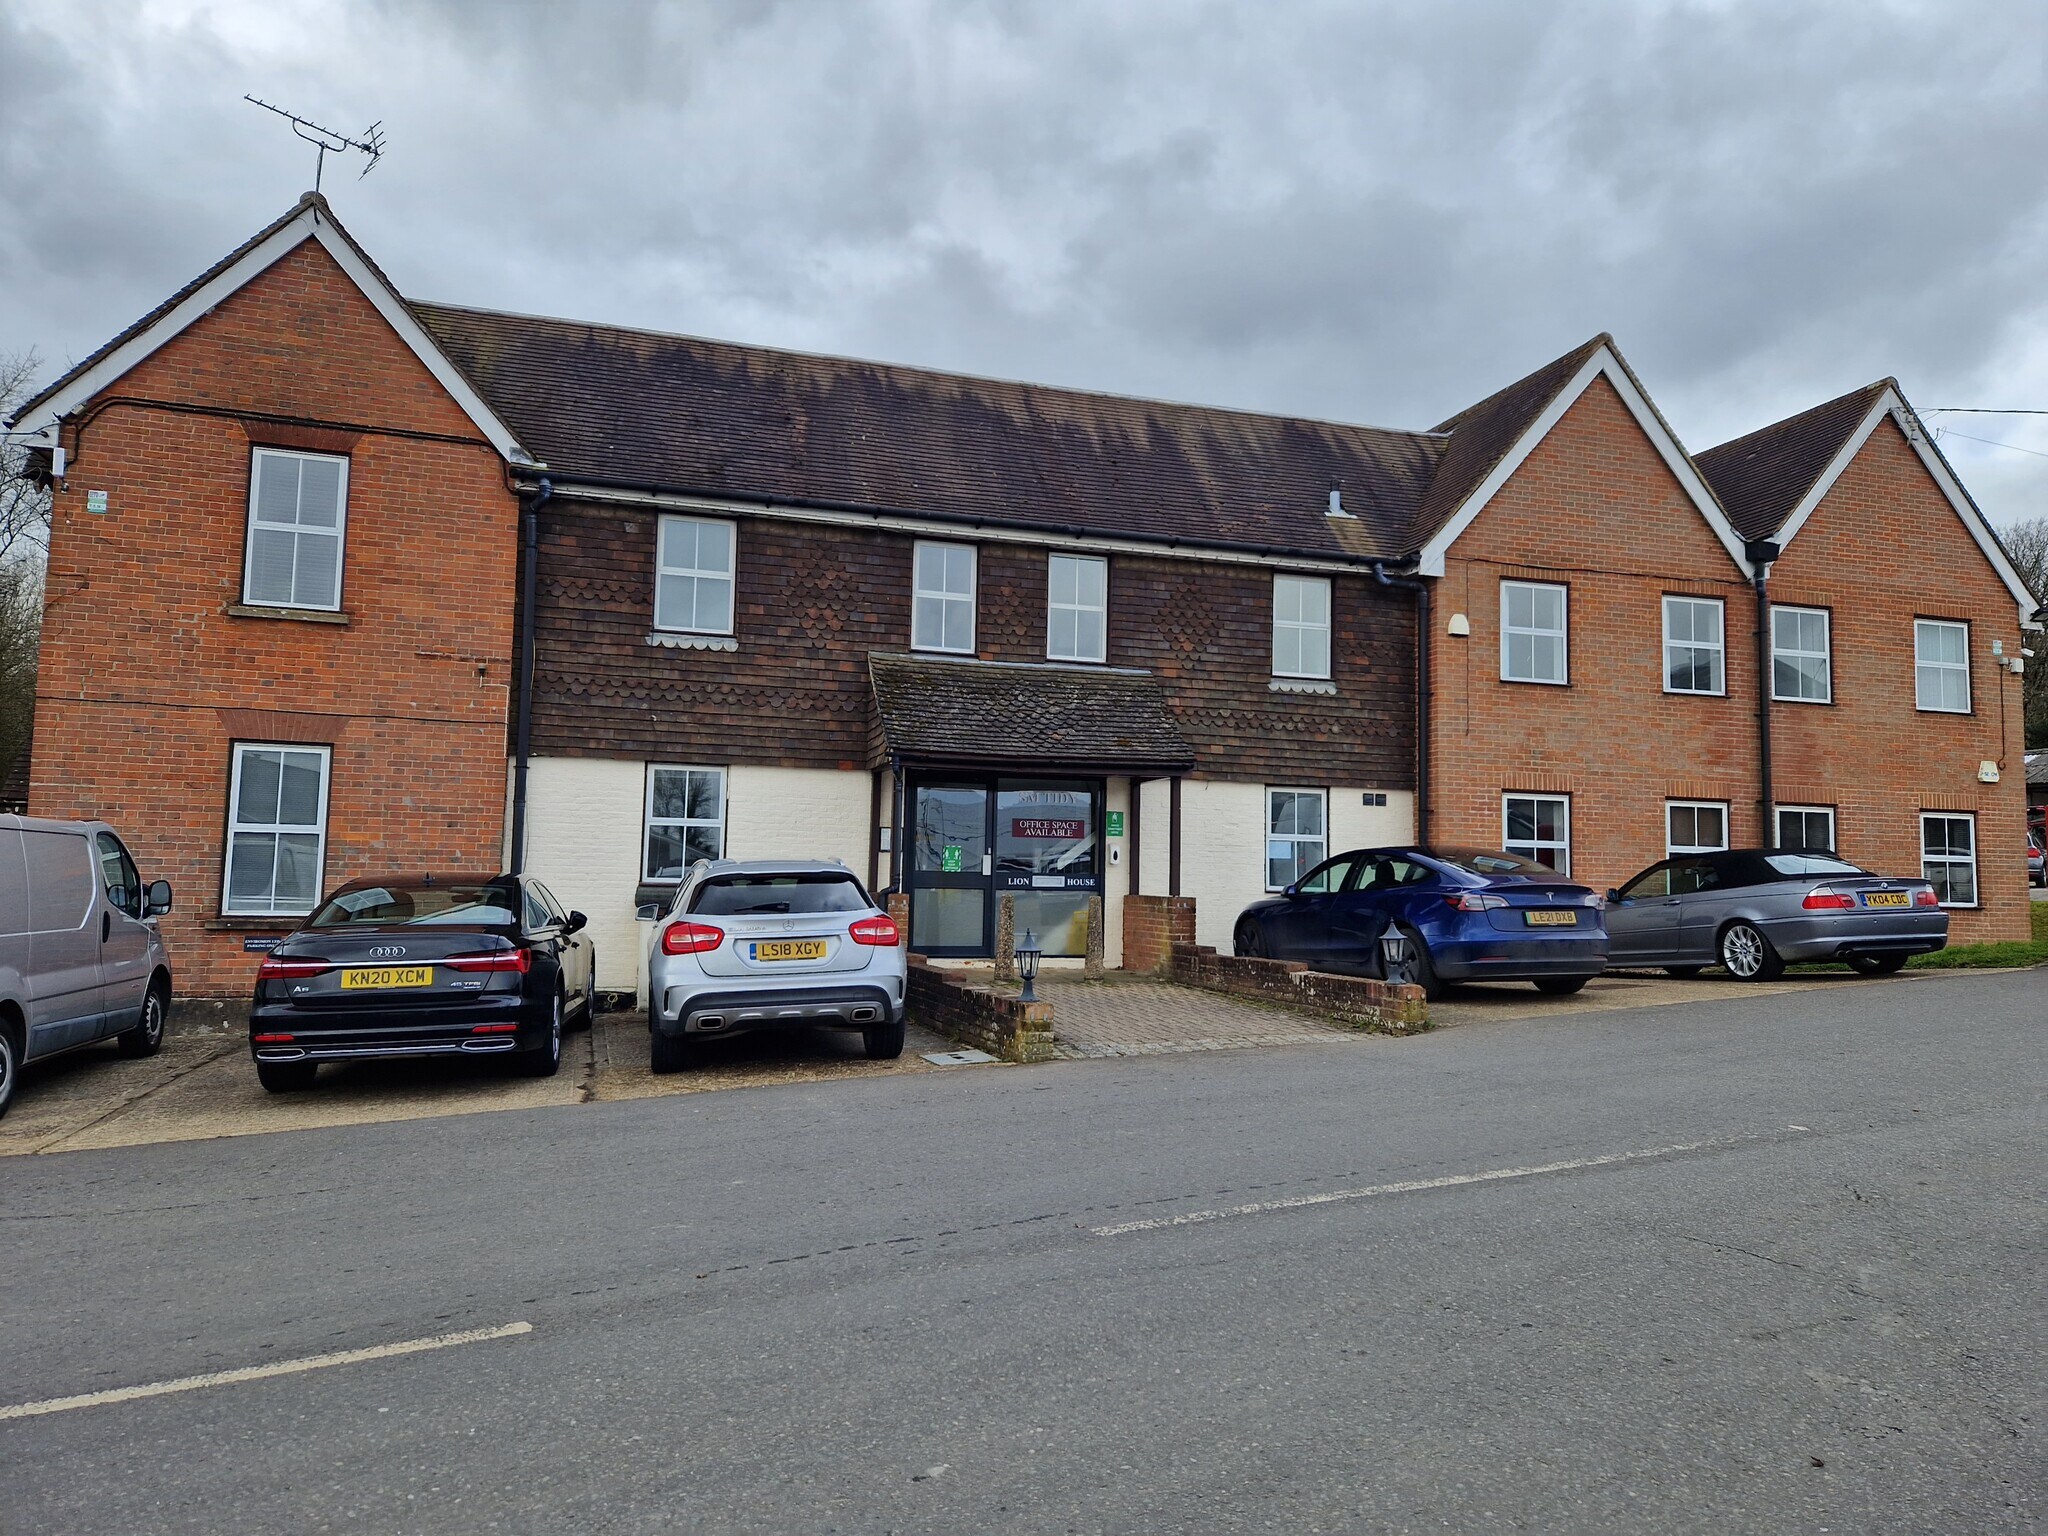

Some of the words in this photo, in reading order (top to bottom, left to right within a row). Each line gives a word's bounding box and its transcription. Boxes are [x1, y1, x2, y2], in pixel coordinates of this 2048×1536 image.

[1019, 820, 1050, 829] OFFICE
[1051, 821, 1078, 830] SPACE
[1024, 829, 1074, 837] AVAILABLE
[1008, 877, 1030, 885] LION
[1067, 878, 1096, 886] HOUSE
[1866, 895, 1889, 904] YK04
[1890, 894, 1908, 904] CDC
[1532, 912, 1554, 922] LE21
[1555, 912, 1573, 922] DXB
[761, 943, 792, 957] LS18
[795, 942, 821, 955] XGY
[349, 971, 391, 985] KN20
[395, 969, 425, 983] XCM
